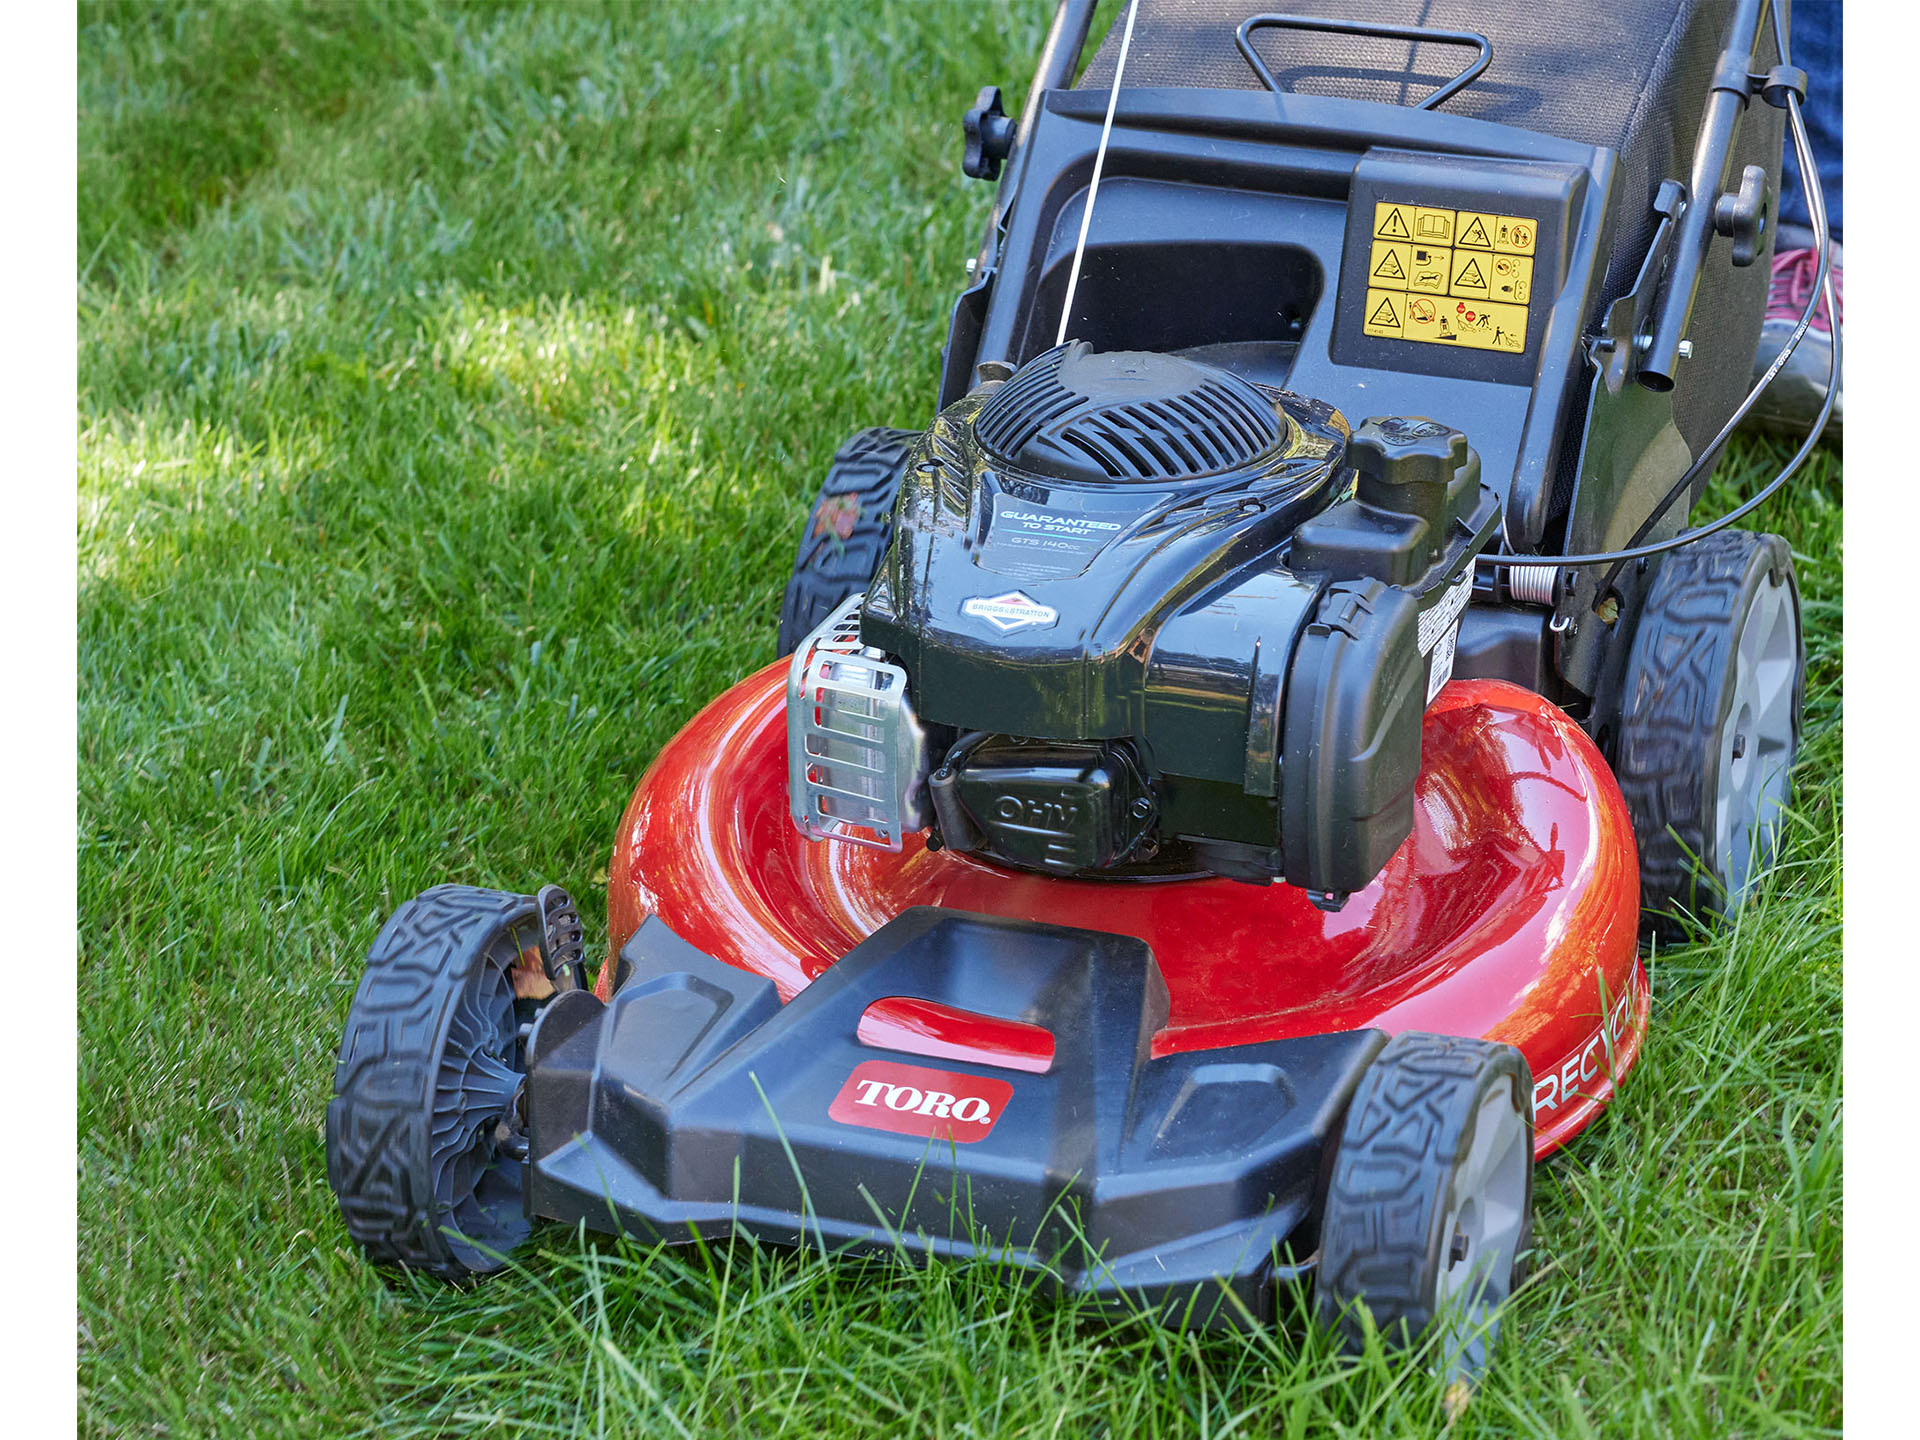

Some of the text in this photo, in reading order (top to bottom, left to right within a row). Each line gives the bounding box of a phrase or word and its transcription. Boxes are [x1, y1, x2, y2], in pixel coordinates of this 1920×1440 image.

[1000, 510, 1121, 531] GUARANTEED
[1022, 521, 1092, 535] TO START
[1011, 537, 1039, 546] GTS
[1042, 540, 1081, 551] 140cc
[995, 795, 1079, 831] OHV
[1531, 963, 1638, 1122] RECYCL
